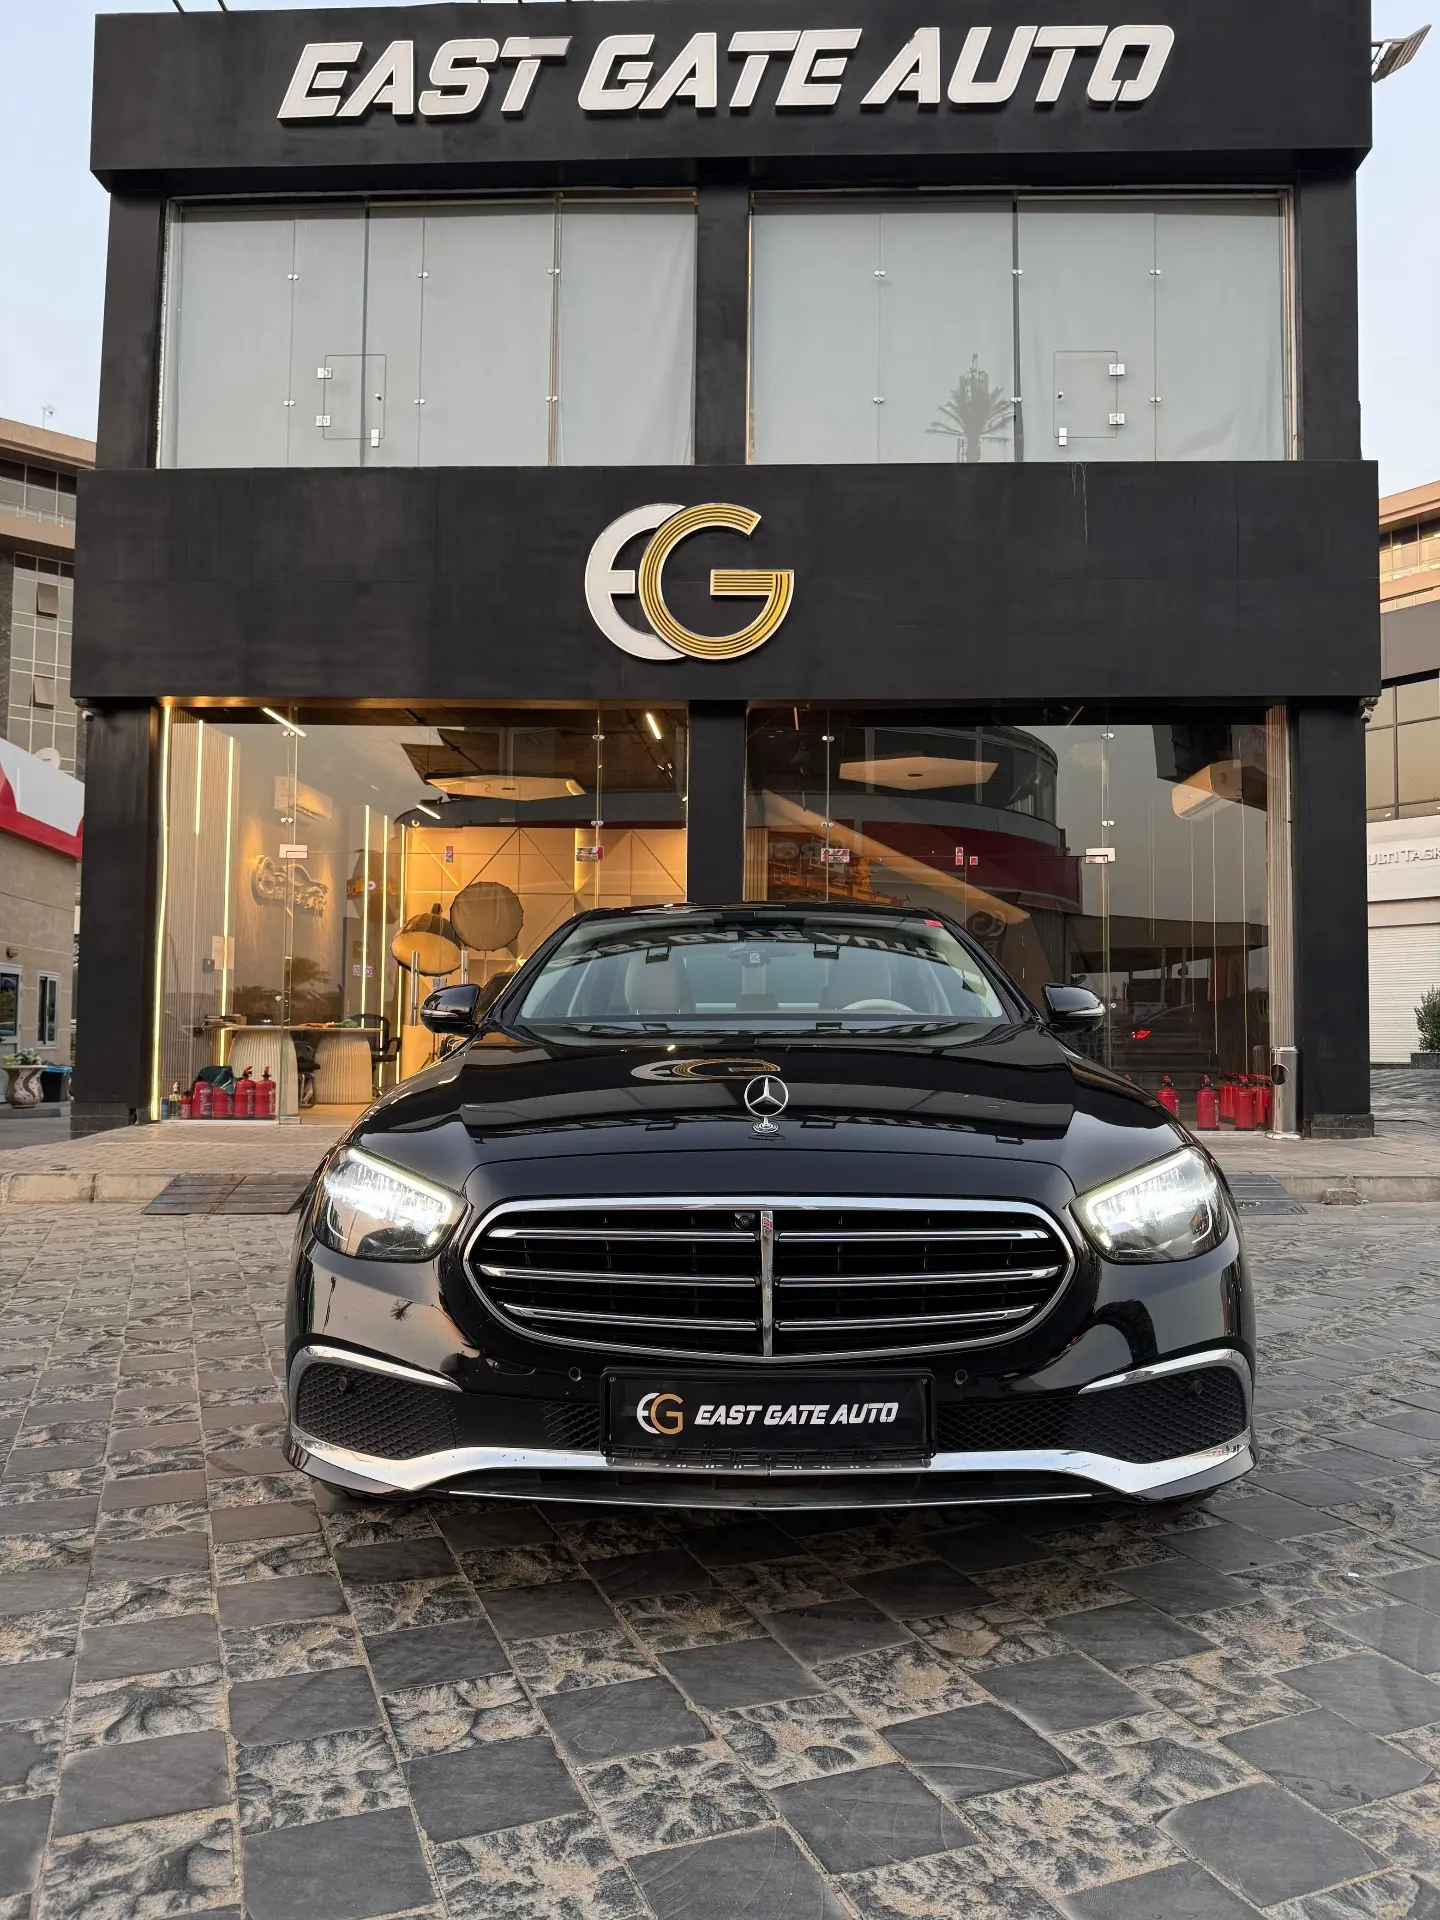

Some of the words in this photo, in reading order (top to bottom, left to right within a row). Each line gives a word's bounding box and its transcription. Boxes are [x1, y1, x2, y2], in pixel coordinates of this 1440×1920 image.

[277, 36, 573, 121] EAST
[578, 28, 863, 116] GATE
[860, 25, 1176, 111] AUTO
[585, 502, 795, 661] EG
[1367, 851, 1400, 866] ULTI
[636, 1392, 684, 1435] EG
[694, 1404, 763, 1425] EAST
[763, 1404, 830, 1426] GATE
[829, 1402, 899, 1424] AUTO
